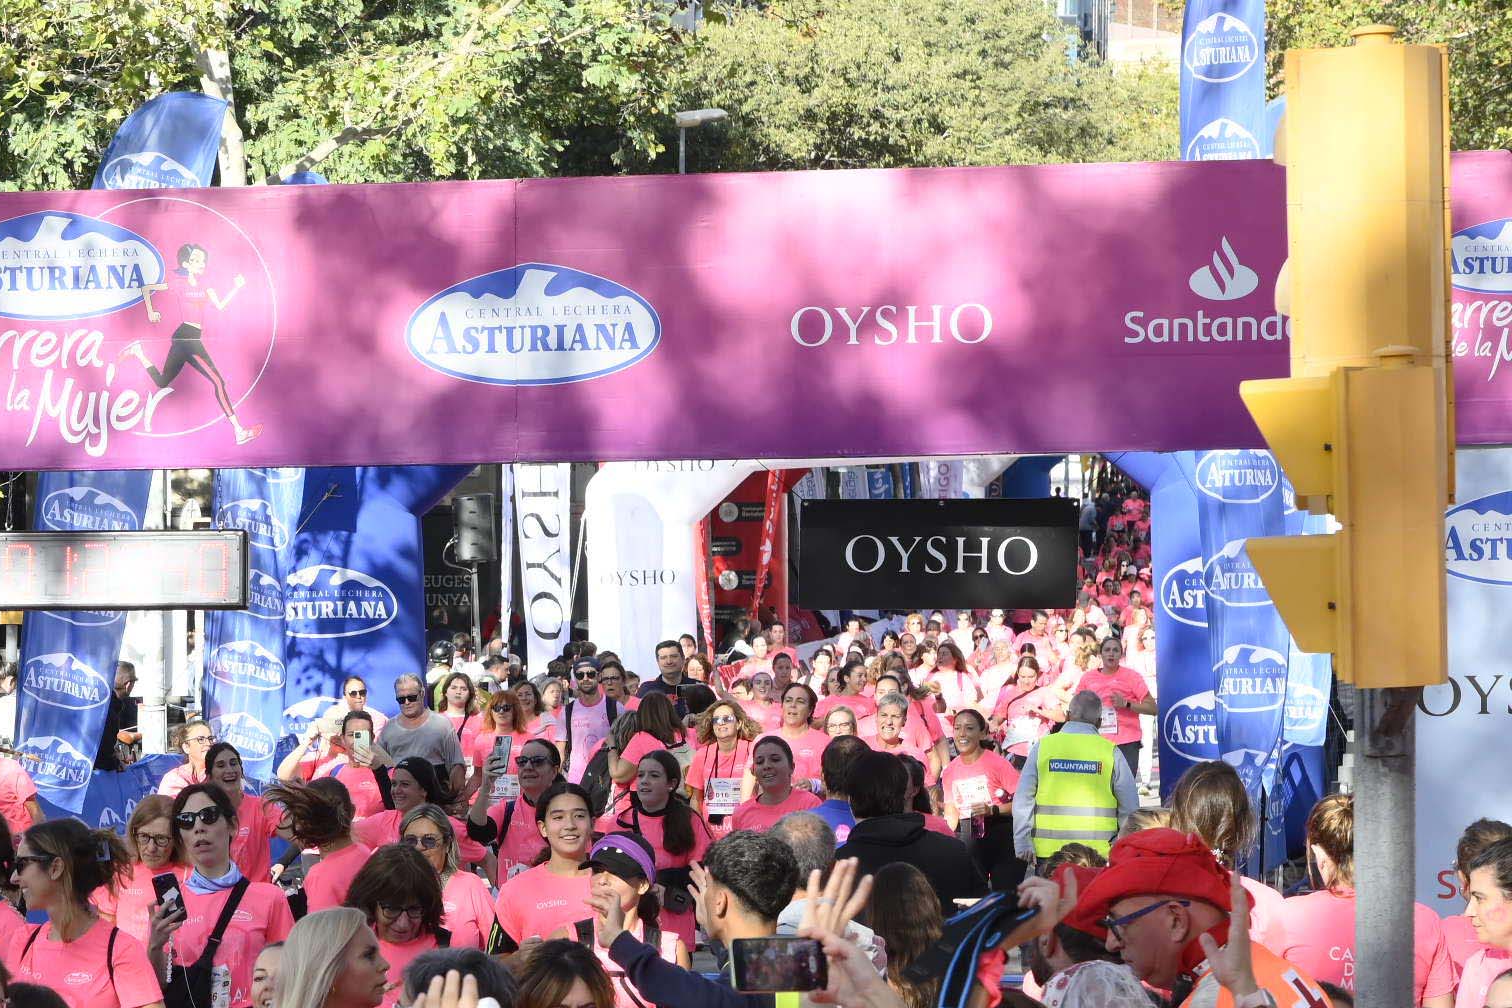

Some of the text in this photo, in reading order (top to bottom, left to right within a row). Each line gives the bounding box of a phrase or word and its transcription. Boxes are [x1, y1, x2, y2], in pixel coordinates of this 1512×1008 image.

[64, 247, 140, 258] LECHERA
[465, 305, 632, 317] CENTRAL LECHERA
[426, 311, 640, 355] ASTURIANA
[791, 303, 993, 348] OYSHO
[1124, 310, 1291, 344] Santand
[6, 373, 28, 412] la
[26, 361, 174, 457] Mujer
[845, 533, 1039, 576] OYSHO
[335, 588, 383, 598] LECHERA
[285, 600, 388, 621] STURIANA
[1049, 761, 1097, 773] VOLUNTARIS
